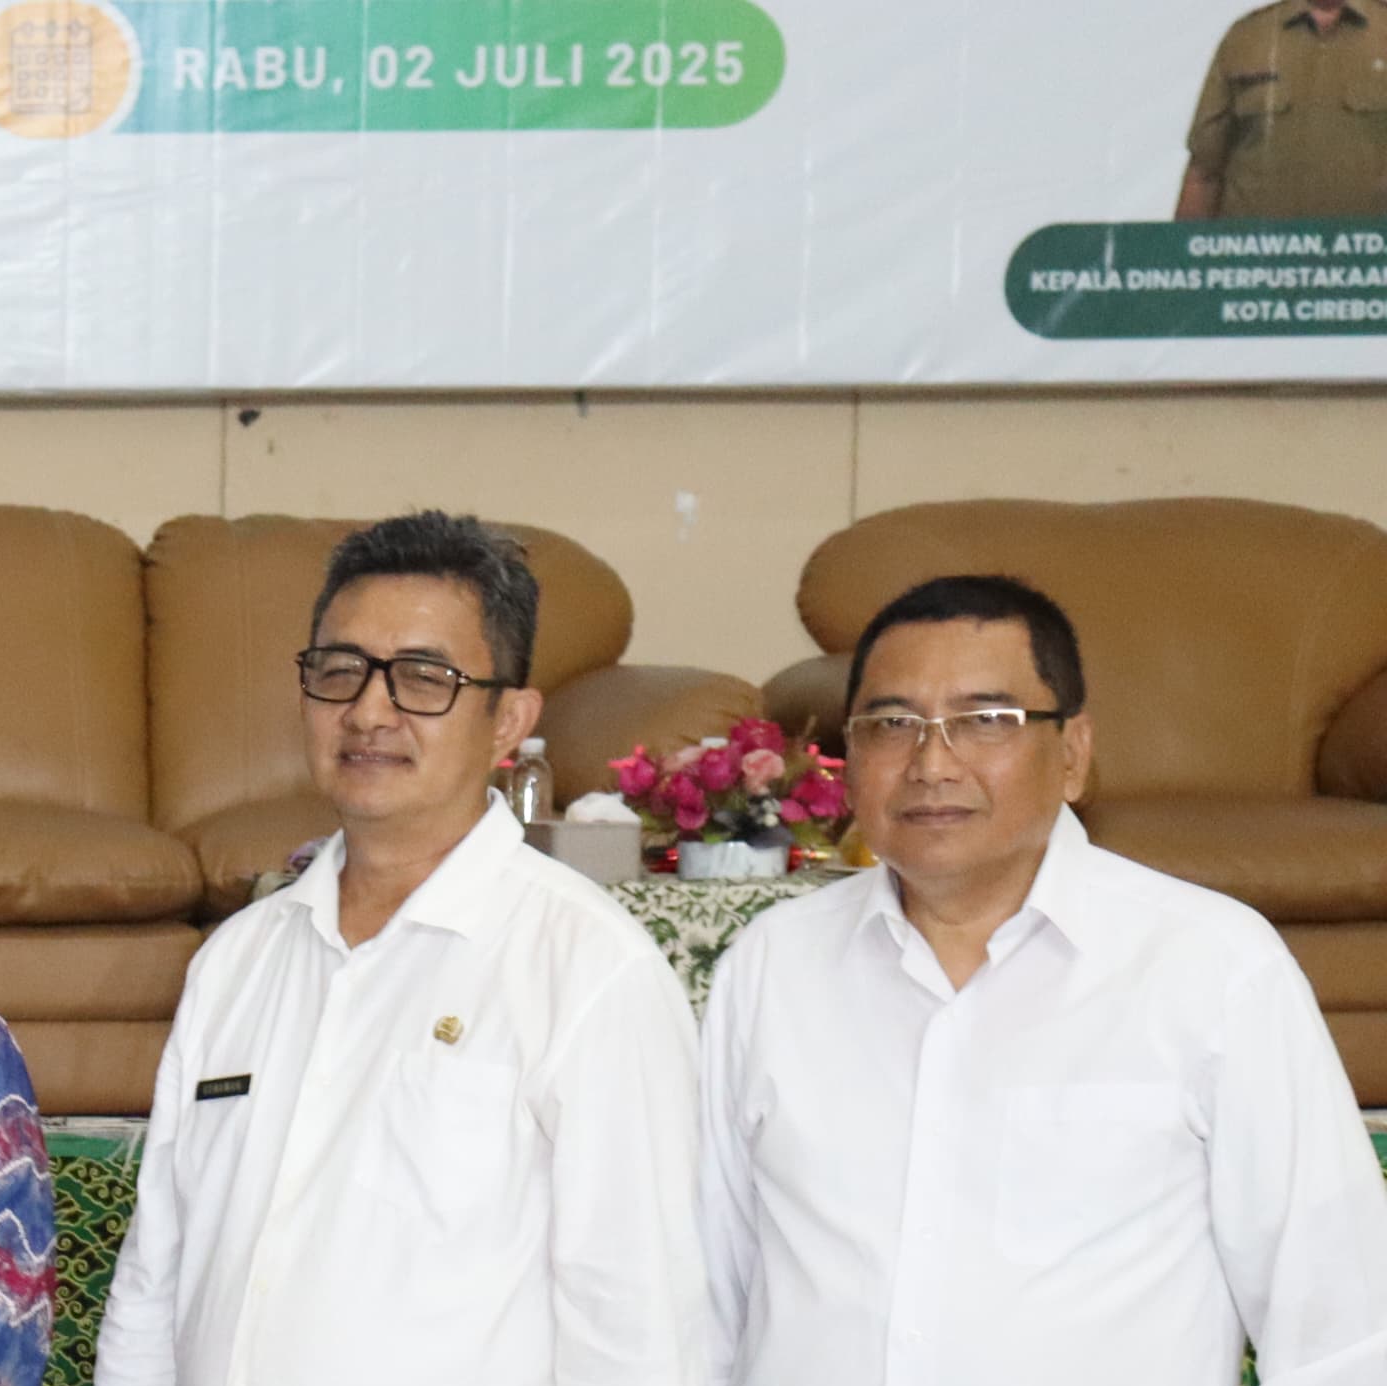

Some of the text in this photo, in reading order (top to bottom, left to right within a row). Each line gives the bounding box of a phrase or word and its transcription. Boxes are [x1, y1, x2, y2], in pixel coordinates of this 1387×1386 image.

[173, 42, 744, 94] RABU, 02 JULI 2025
[1188, 233, 1327, 257] GUNAWAN,
[1031, 269, 1123, 291] KEPALA
[1126, 268, 1203, 290] DINAS
[1222, 298, 1387, 322] KOTA CIREBO
